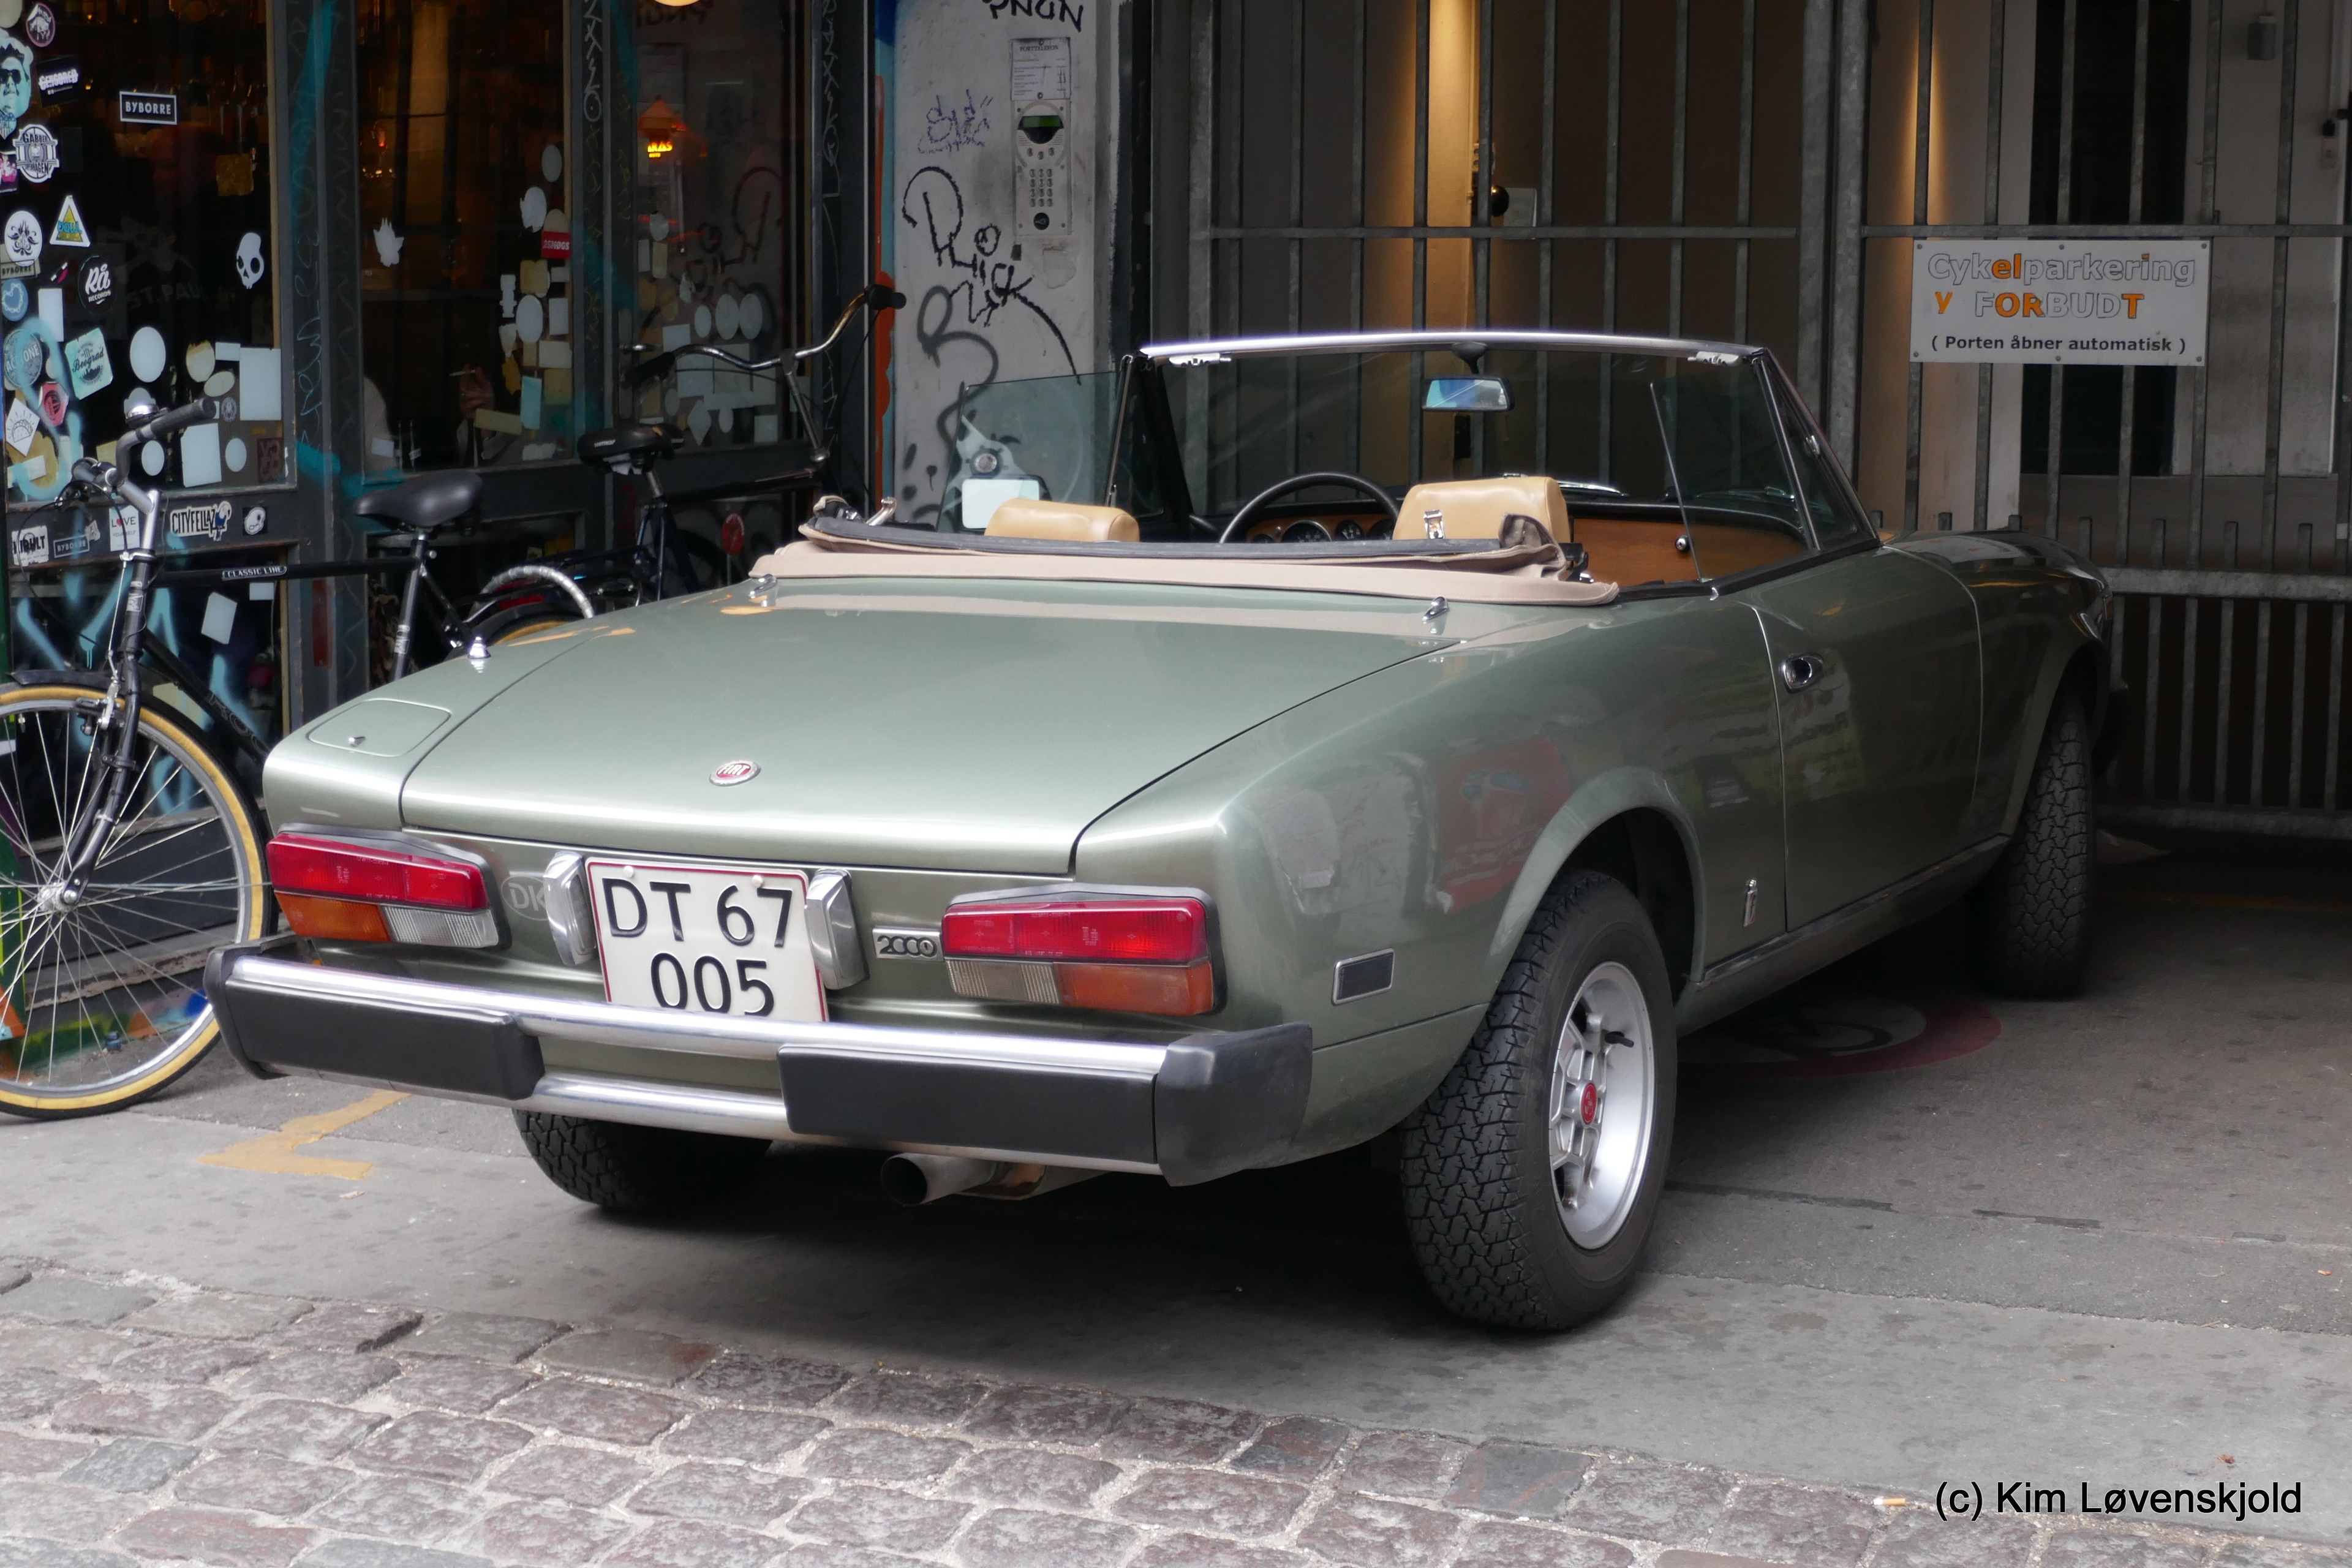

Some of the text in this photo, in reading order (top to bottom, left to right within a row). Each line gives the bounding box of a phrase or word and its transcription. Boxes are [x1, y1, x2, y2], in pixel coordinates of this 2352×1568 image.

[125, 101, 171, 115] BYBORRE
[1928, 252, 2195, 287] Cykelparkering
[88, 290, 111, 303] RECORDS
[1974, 291, 2144, 319] FORBUDT
[1945, 336, 2003, 349] Porten
[2011, 335, 2062, 350] åbner
[2068, 336, 2171, 352] automatisk
[57, 539, 86, 552] BYBORE
[227, 567, 284, 578] CLASSIC LINE
[601, 877, 793, 948] DT 67
[877, 935, 938, 957] 2000
[650, 952, 774, 1017] 005
